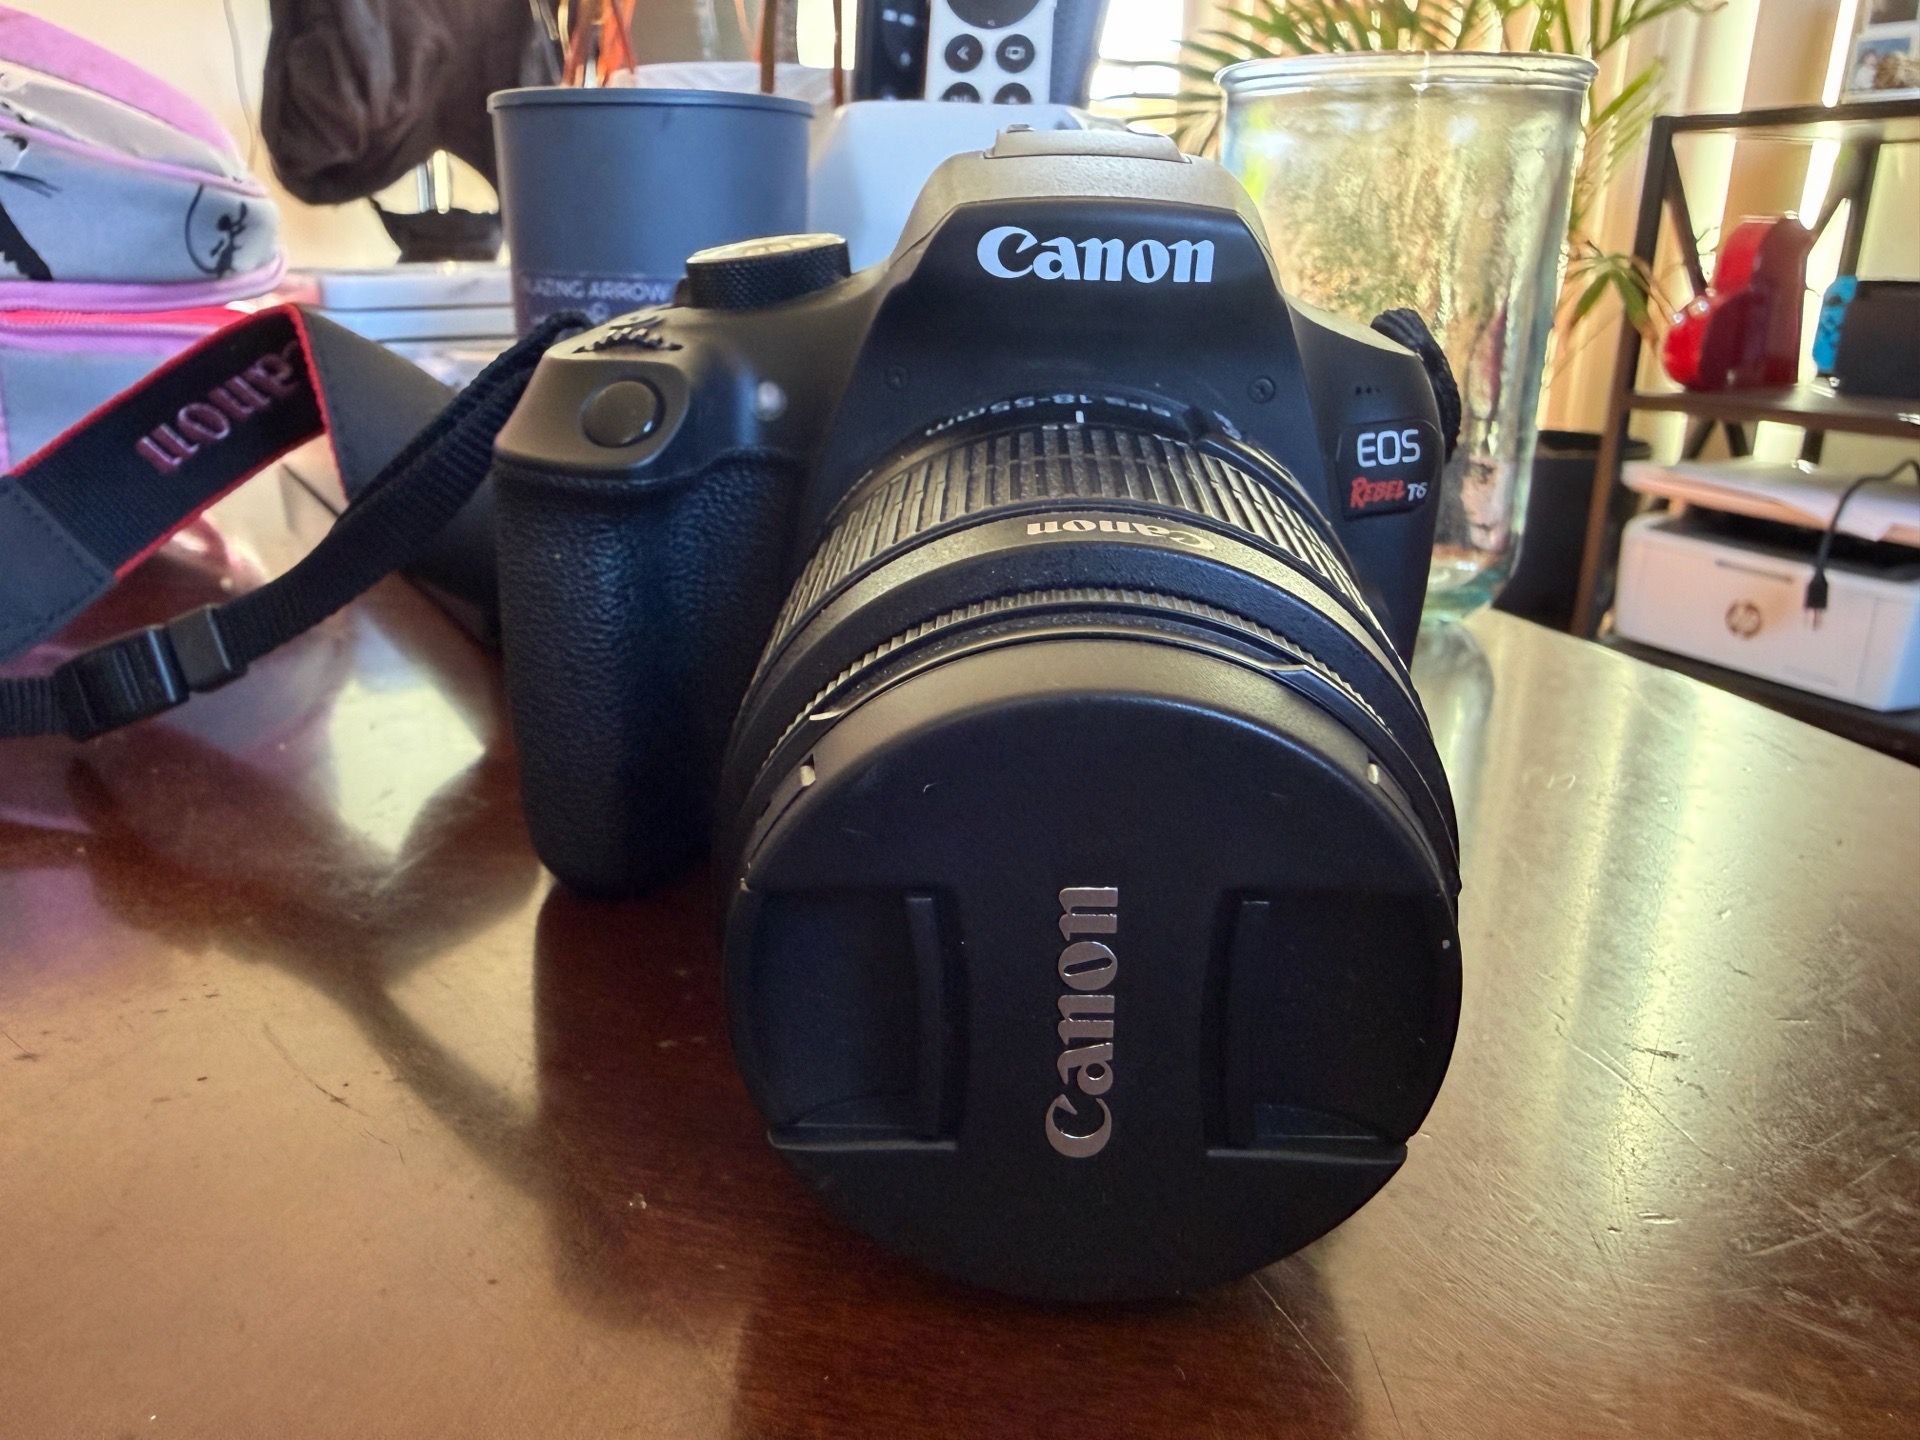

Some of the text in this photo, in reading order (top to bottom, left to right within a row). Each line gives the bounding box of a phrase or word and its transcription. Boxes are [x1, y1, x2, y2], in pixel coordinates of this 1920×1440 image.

[977, 226, 1215, 283] Canon
[135, 342, 298, 473] anon
[1357, 428, 1421, 468] EOS
[1407, 482, 1428, 502] T6
[1027, 519, 1215, 550] Canon
[1045, 886, 1118, 1158] Canon
